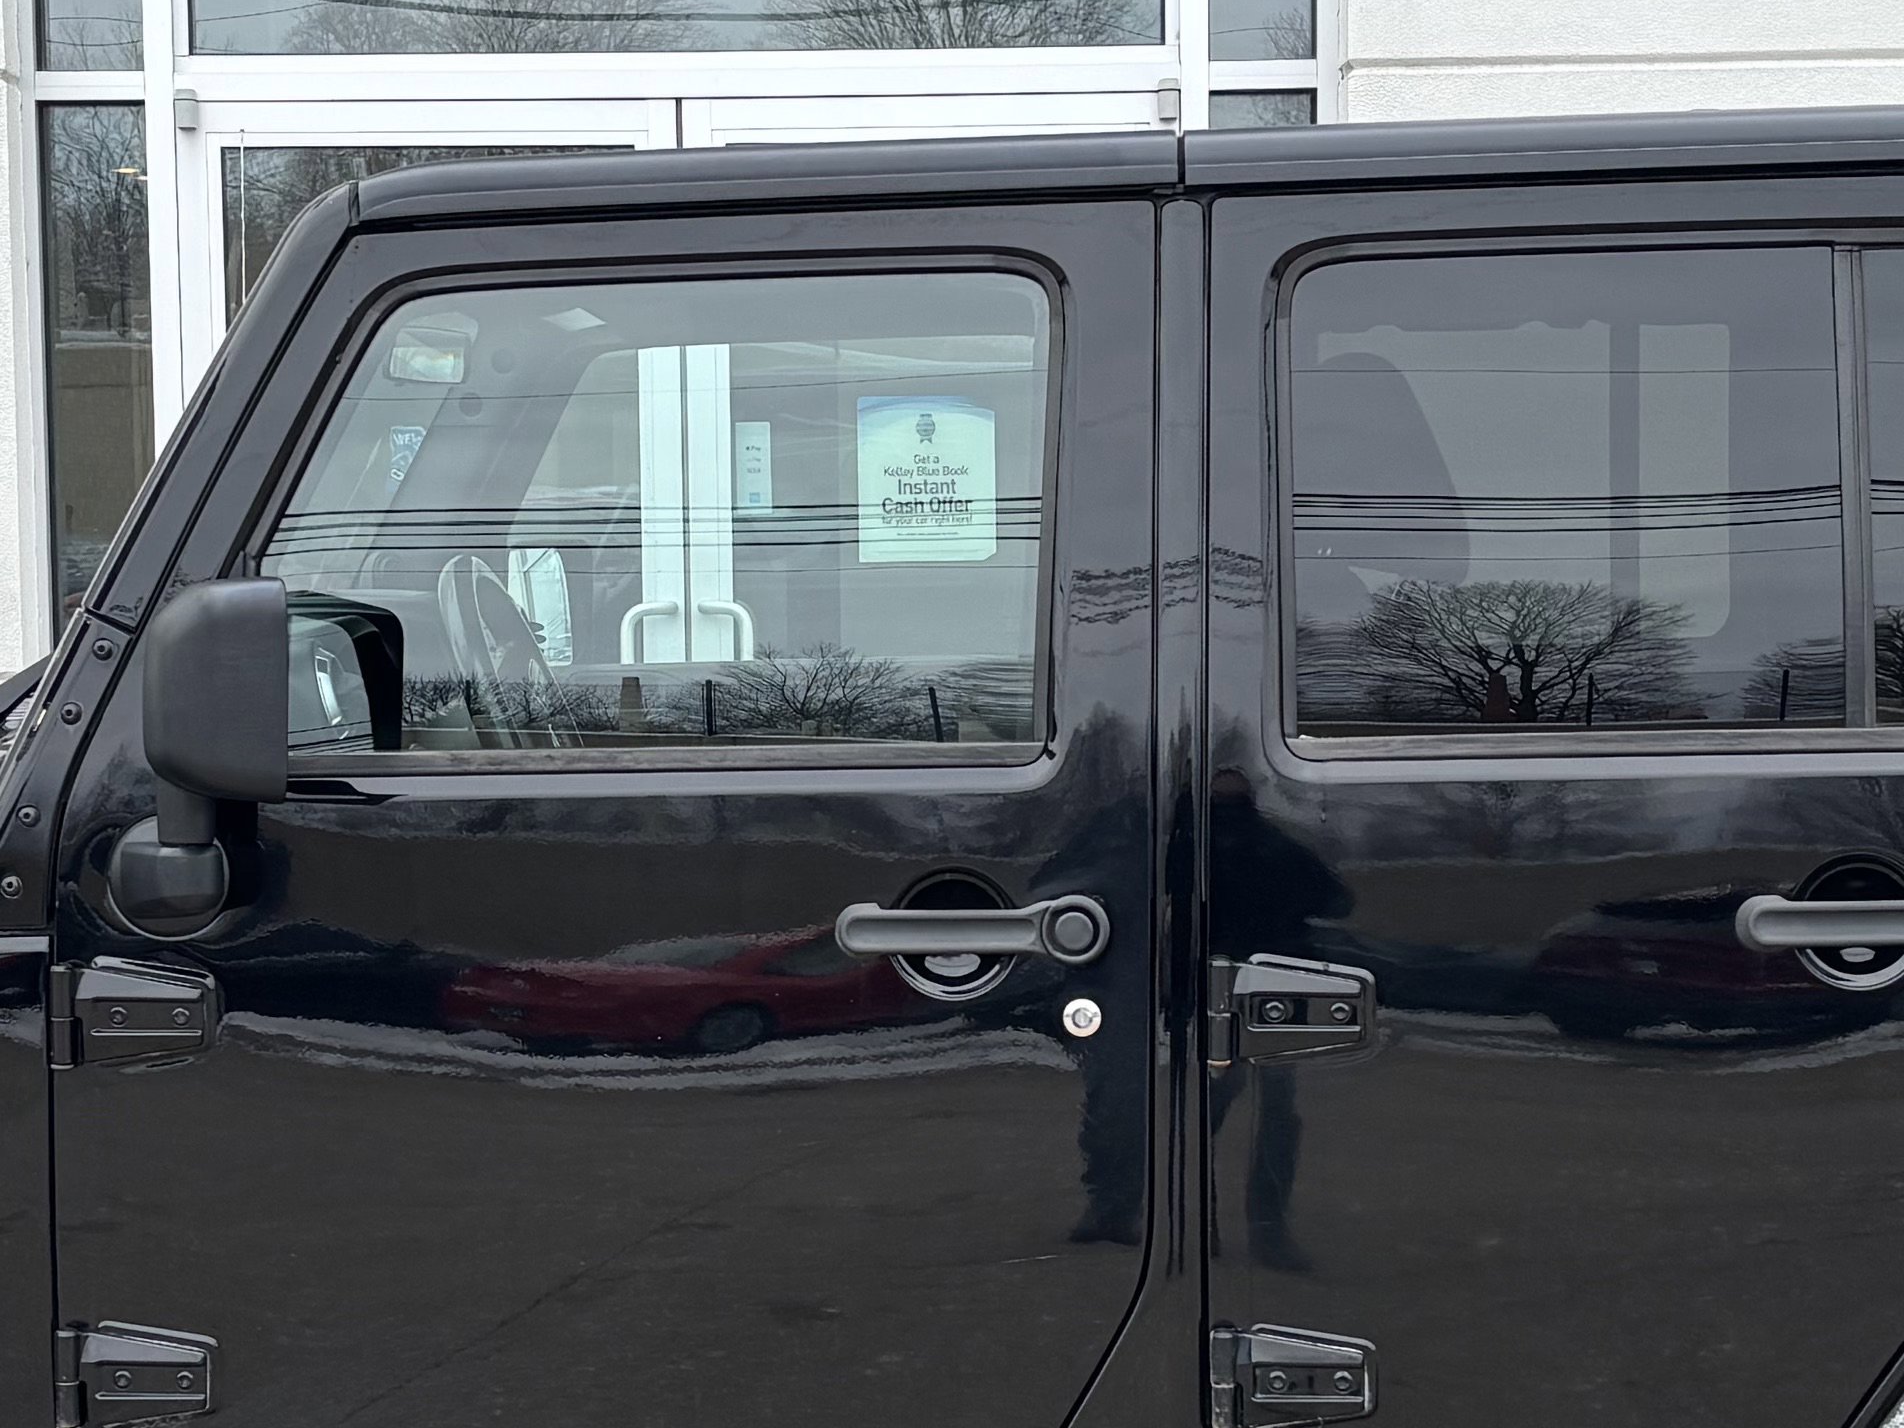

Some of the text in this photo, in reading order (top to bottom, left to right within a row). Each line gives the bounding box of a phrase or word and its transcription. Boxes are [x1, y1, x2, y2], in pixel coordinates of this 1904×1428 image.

[914, 454, 940, 464] Get a
[884, 465, 968, 478] Kelley Blue Book
[898, 479, 956, 495] Instant
[882, 497, 973, 514] Cash Offer
